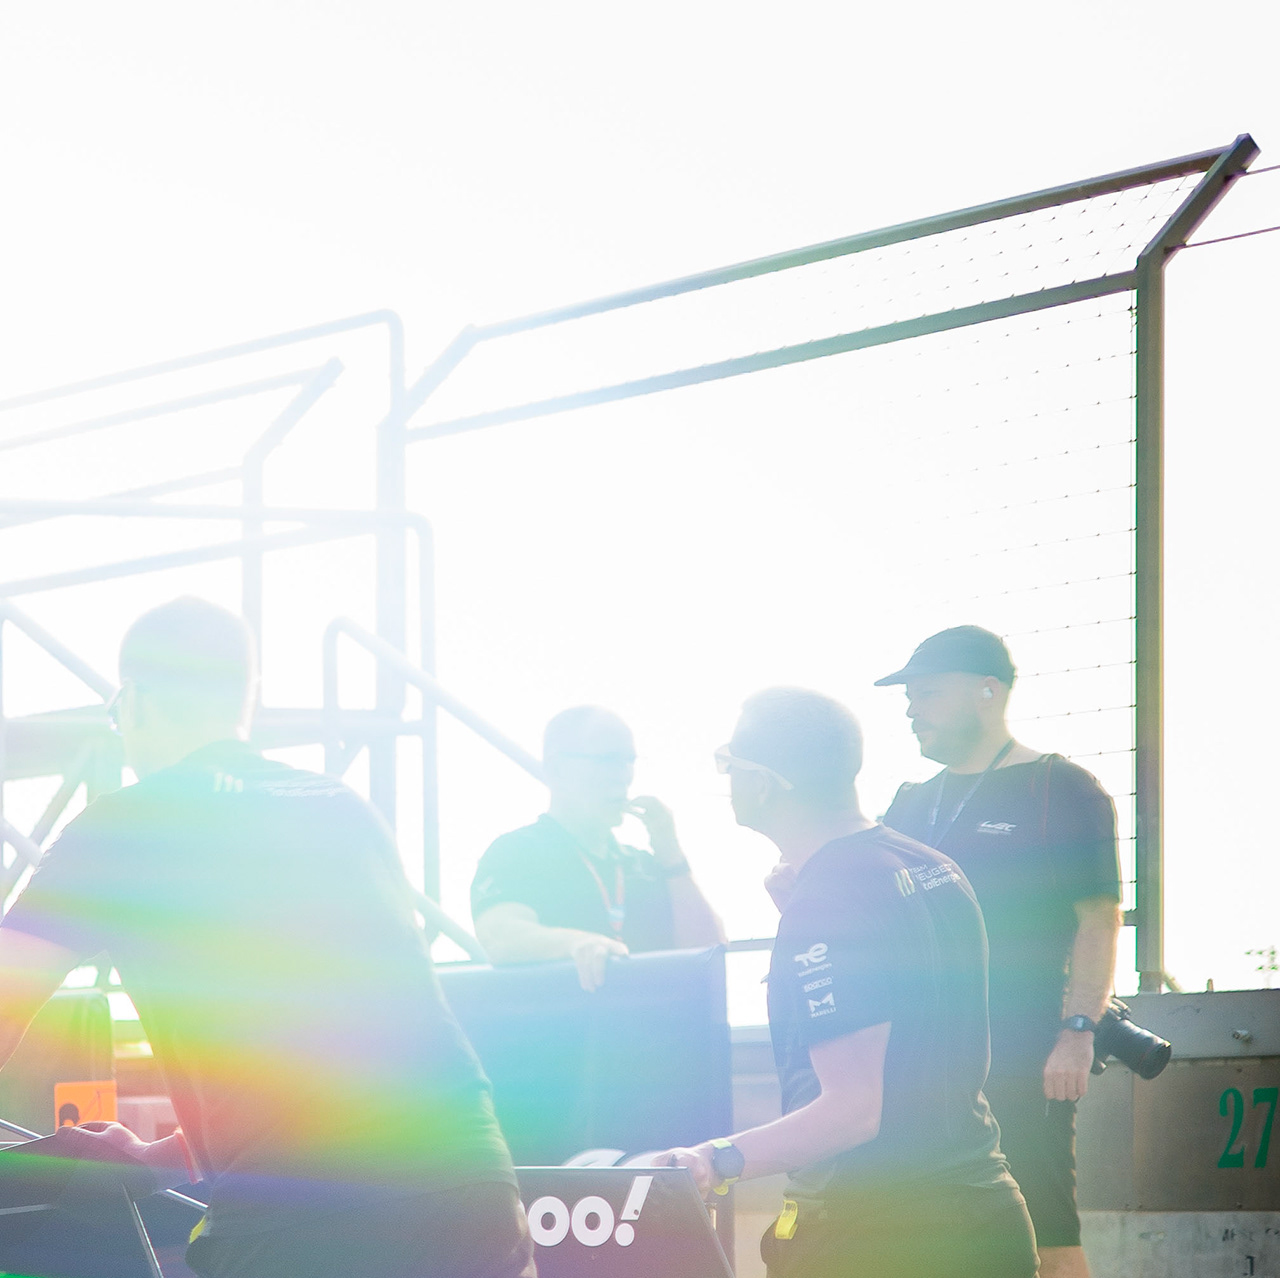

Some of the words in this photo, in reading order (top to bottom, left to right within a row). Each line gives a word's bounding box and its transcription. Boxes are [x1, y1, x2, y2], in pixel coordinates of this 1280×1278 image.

[915, 863, 953, 882] EUGEO
[1217, 1087, 1279, 1169] 27
[527, 1175, 654, 1247] oo!
